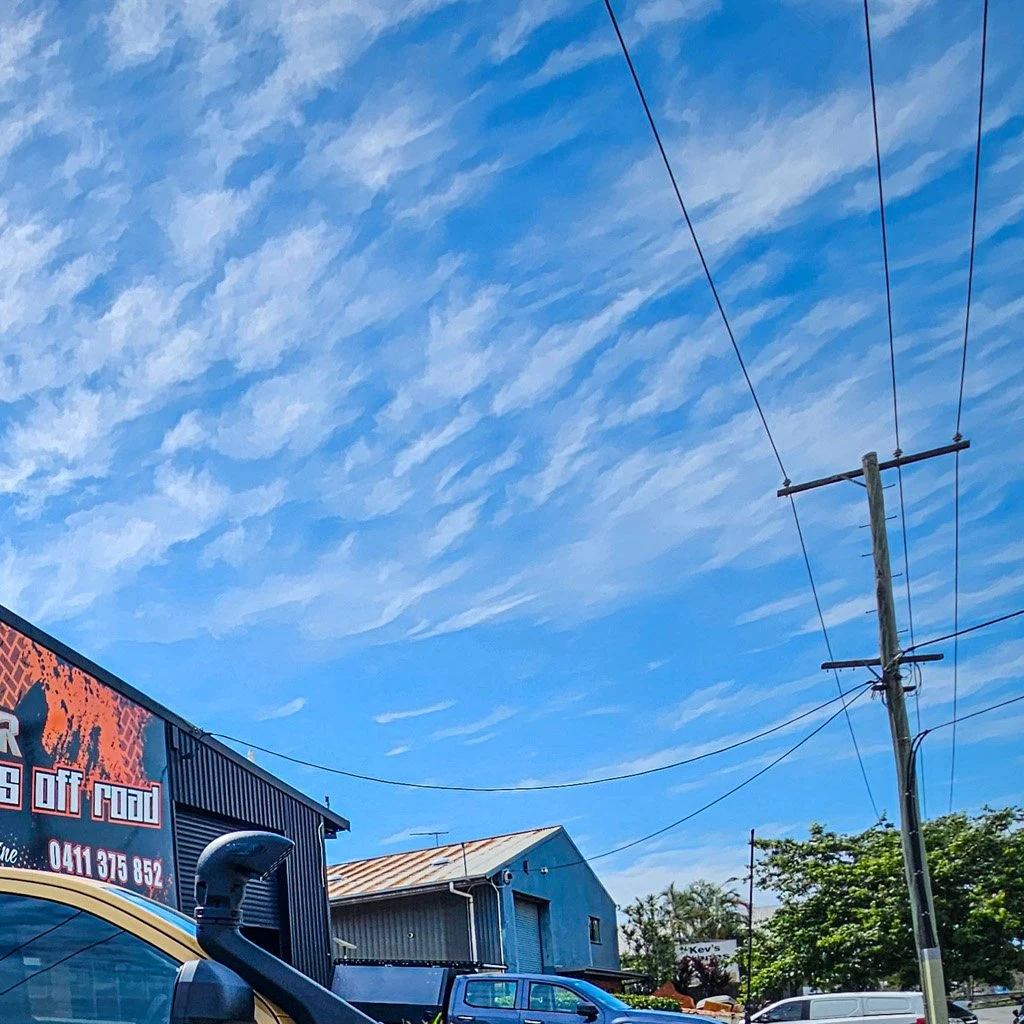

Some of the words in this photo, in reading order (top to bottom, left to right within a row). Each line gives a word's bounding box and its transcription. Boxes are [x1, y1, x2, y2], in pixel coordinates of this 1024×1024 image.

[35, 769, 83, 813] off
[94, 782, 160, 824] road
[49, 841, 92, 877] 0411
[97, 850, 127, 882] 375
[133, 857, 163, 888] 852
[689, 943, 721, 954] Kev's
